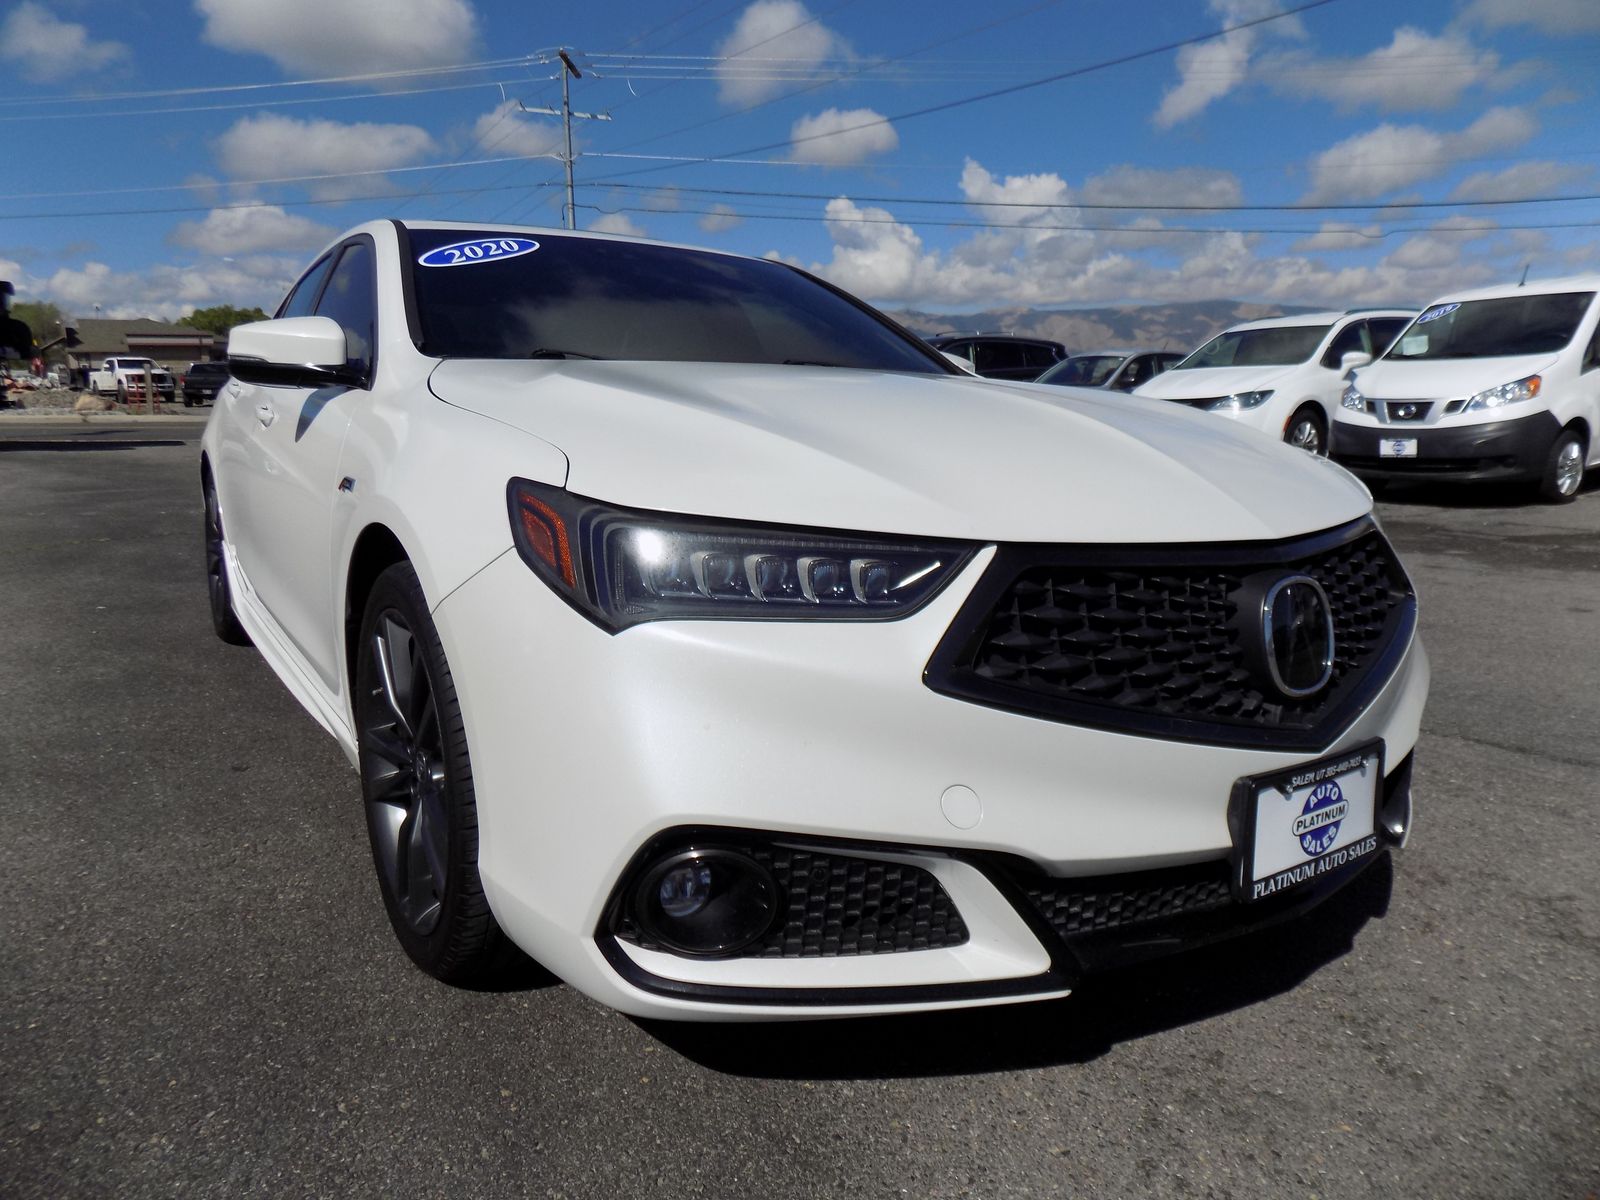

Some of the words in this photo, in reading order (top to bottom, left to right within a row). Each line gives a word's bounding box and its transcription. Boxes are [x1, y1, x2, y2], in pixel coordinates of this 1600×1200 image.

[444, 240, 519, 264] 2020
[1309, 784, 1339, 809] AUTO
[1296, 804, 1346, 833] PLATINUM
[1303, 825, 1337, 853] SALES
[1253, 863, 1316, 899] PLATINUM
[1317, 850, 1348, 875] AUTO
[1348, 836, 1377, 861] SALES
